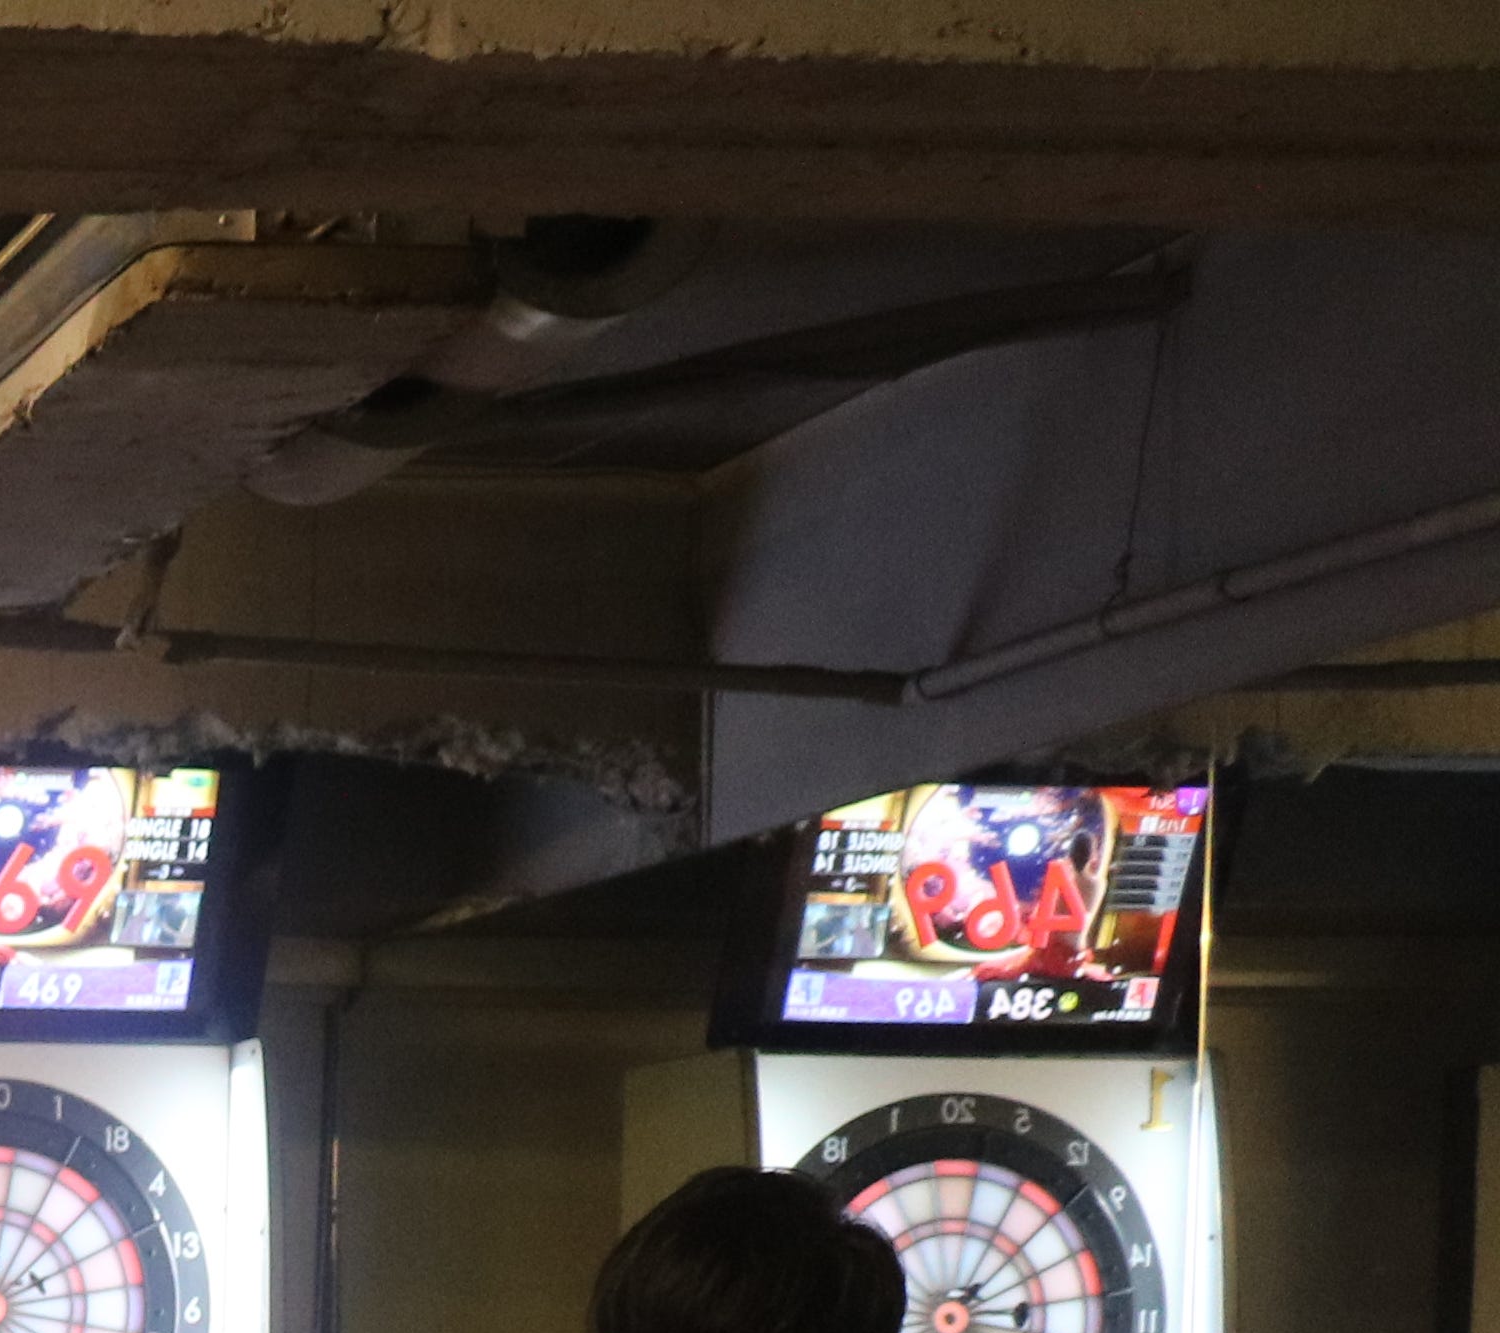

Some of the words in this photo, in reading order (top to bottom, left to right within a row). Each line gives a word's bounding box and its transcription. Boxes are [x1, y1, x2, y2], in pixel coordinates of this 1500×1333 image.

[126, 817, 183, 838] SINGLE
[125, 839, 180, 861] SINGLE
[186, 840, 209, 862] 14
[17, 973, 83, 1005] 469
[56, 1096, 61, 1119] 1
[105, 1126, 130, 1152] 18
[149, 1171, 165, 1196] 4
[173, 1231, 200, 1257] 13
[185, 1297, 201, 1323] 6
